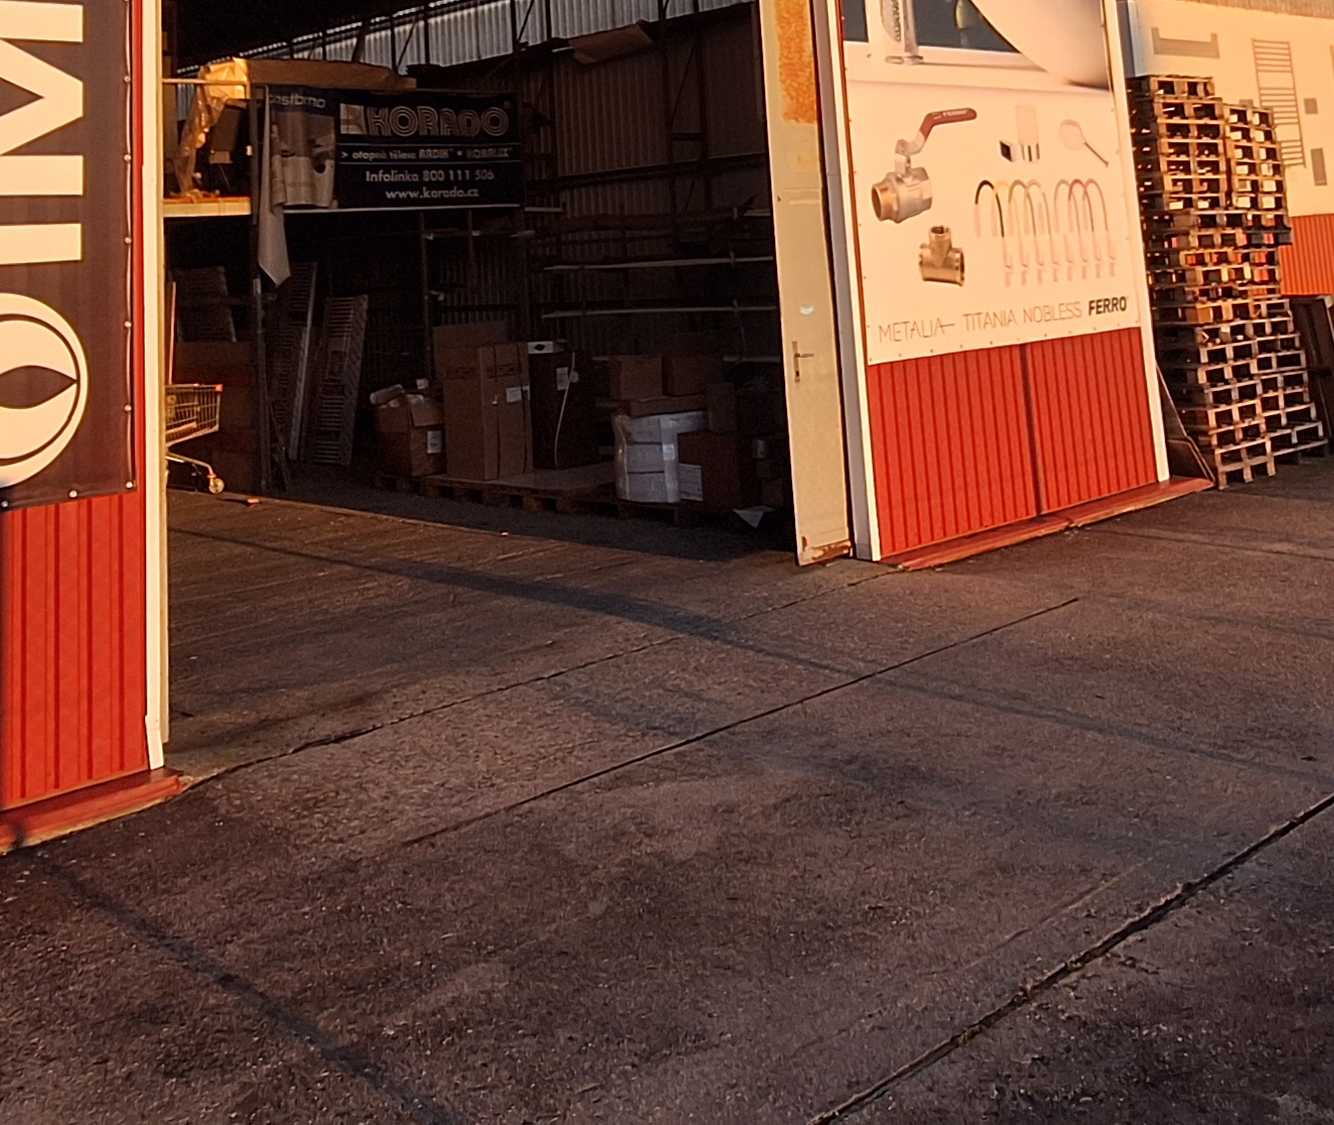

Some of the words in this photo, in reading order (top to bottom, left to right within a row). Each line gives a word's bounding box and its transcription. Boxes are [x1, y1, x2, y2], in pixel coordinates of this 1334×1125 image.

[367, 106, 509, 137] KORADO
[366, 170, 418, 182] Infolinka
[422, 169, 445, 182] 800
[449, 169, 470, 181] 111
[385, 187, 479, 200] www.korado.cz
[963, 309, 1017, 331] TITANIA
[1023, 301, 1082, 324] NOBLESS
[1088, 296, 1127, 316] FERRO
